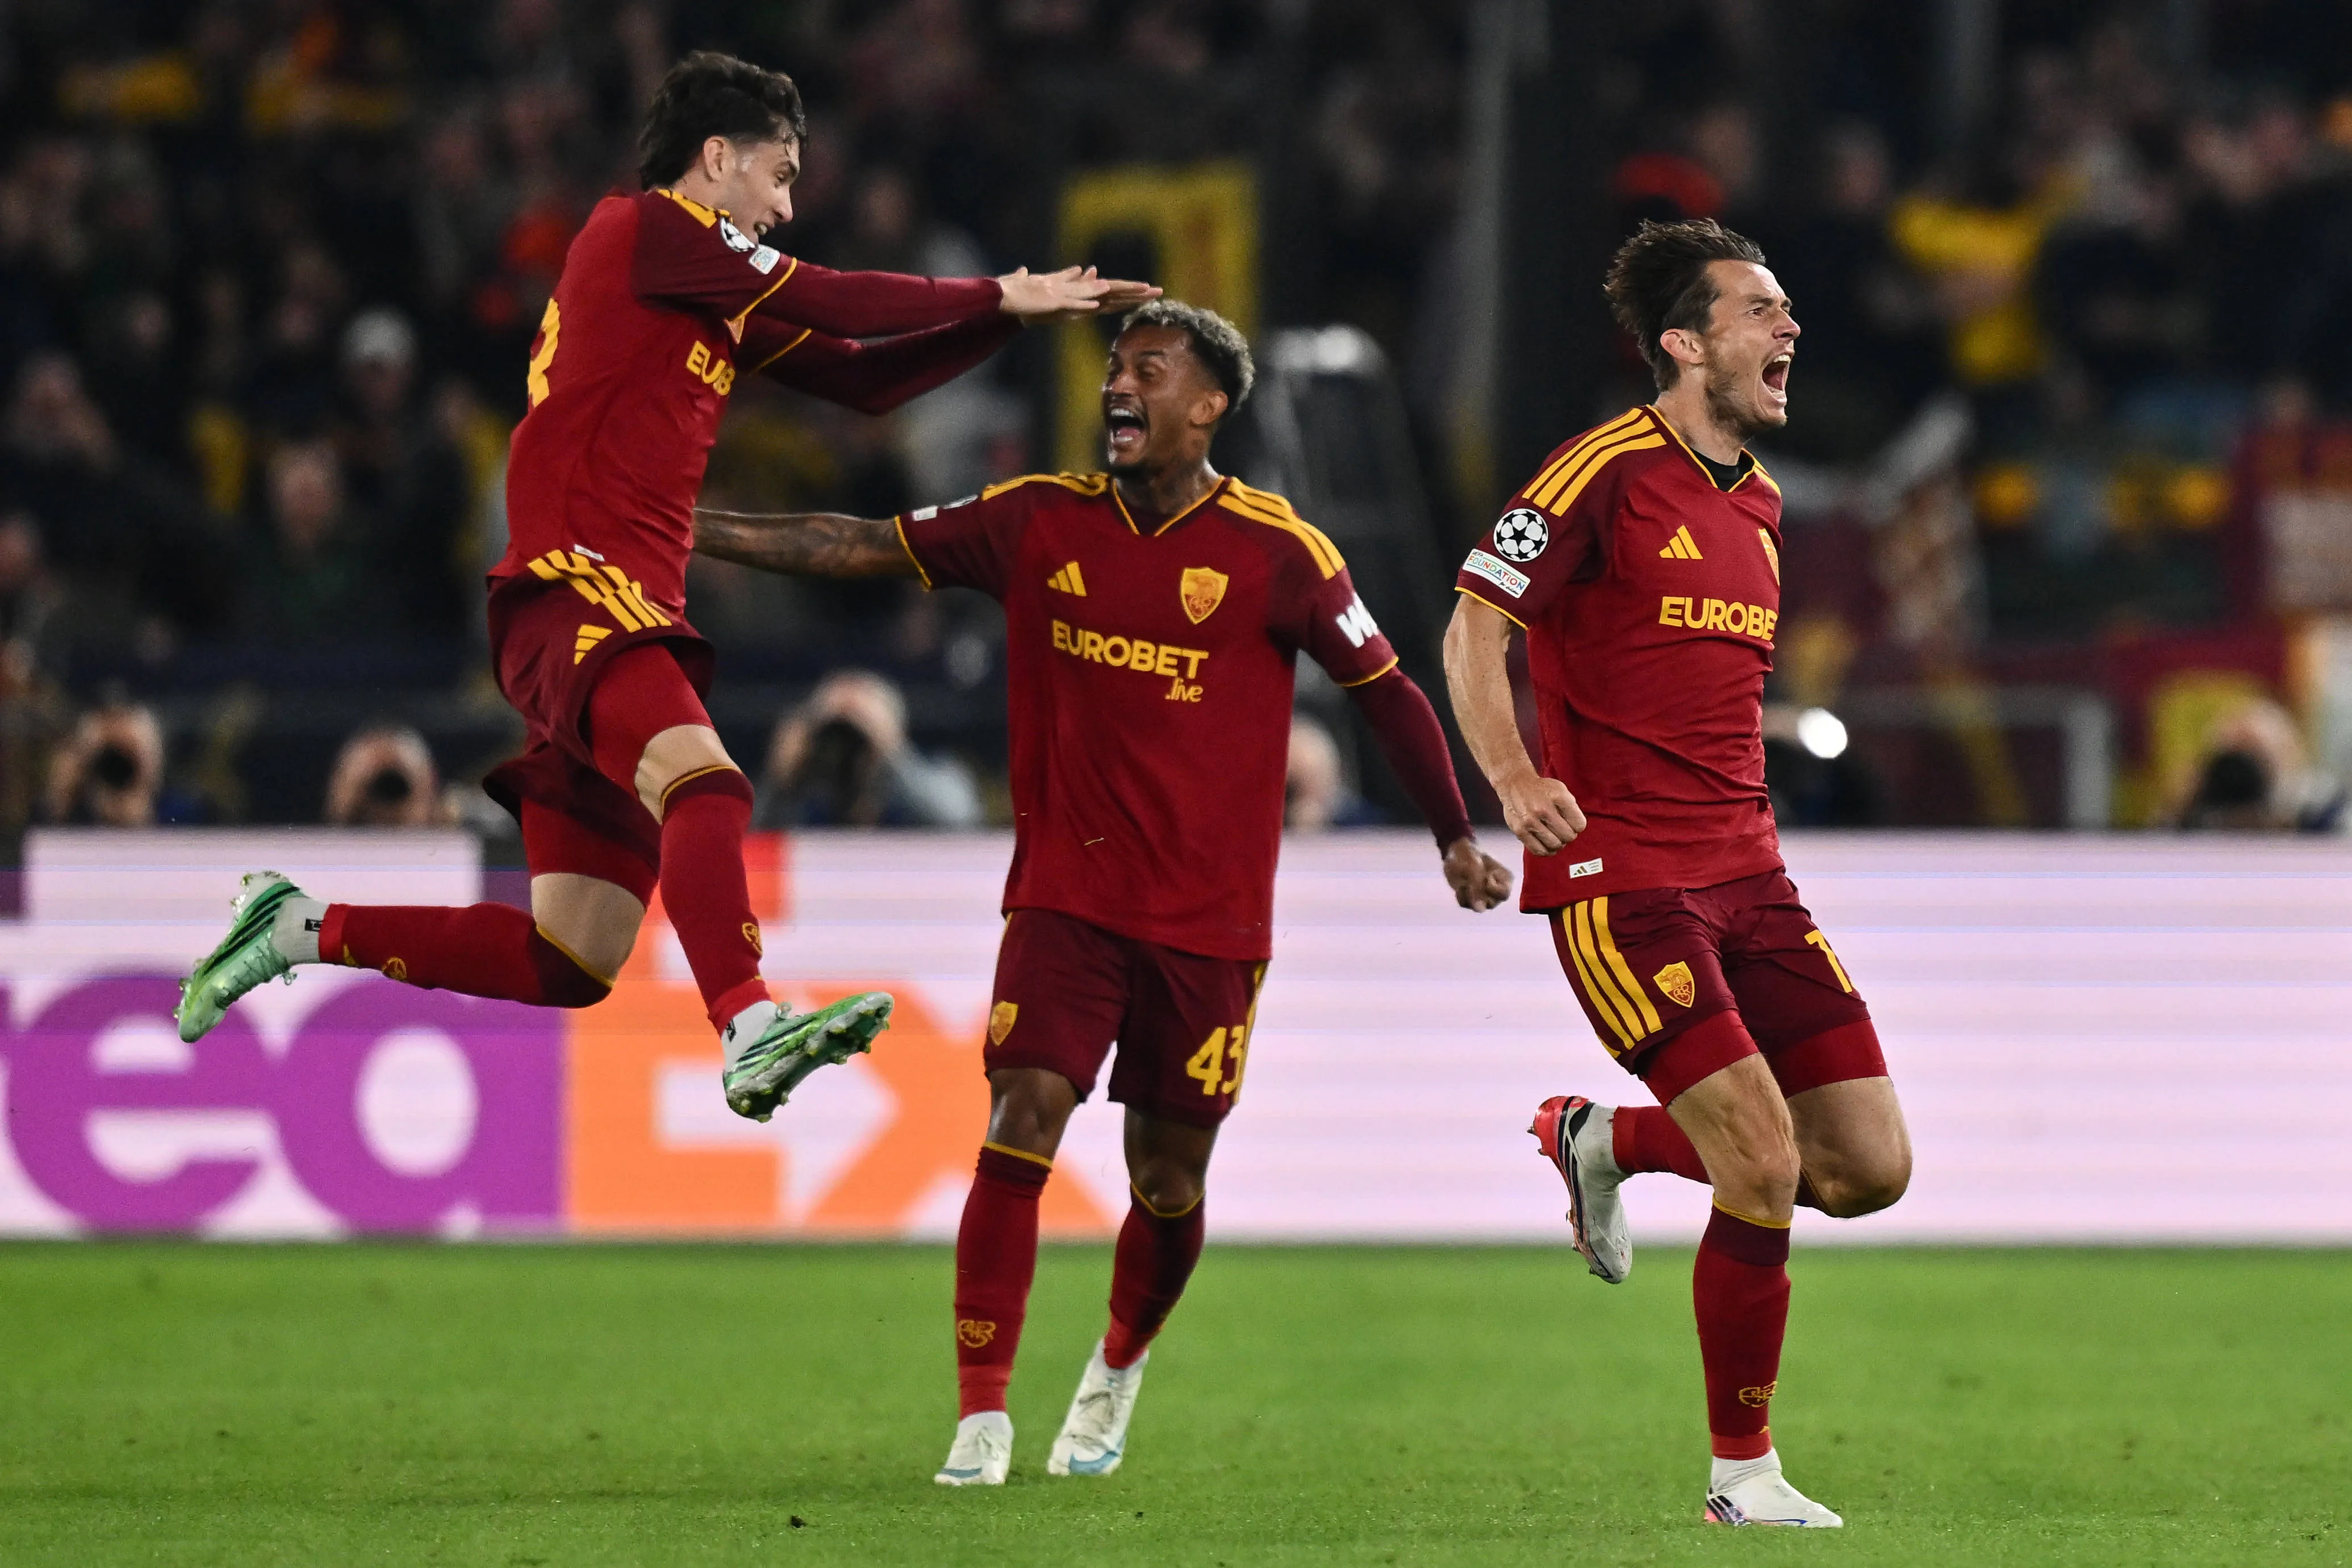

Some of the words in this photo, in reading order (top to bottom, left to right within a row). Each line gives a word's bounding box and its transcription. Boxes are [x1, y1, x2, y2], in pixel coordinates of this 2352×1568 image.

[1468, 555, 1526, 591] FOUNDATION
[1052, 618, 1209, 679] EUROBET
[1804, 929, 1853, 993] 1
[0, 826, 1119, 1235] edEx
[1186, 1025, 1246, 1096] 43
